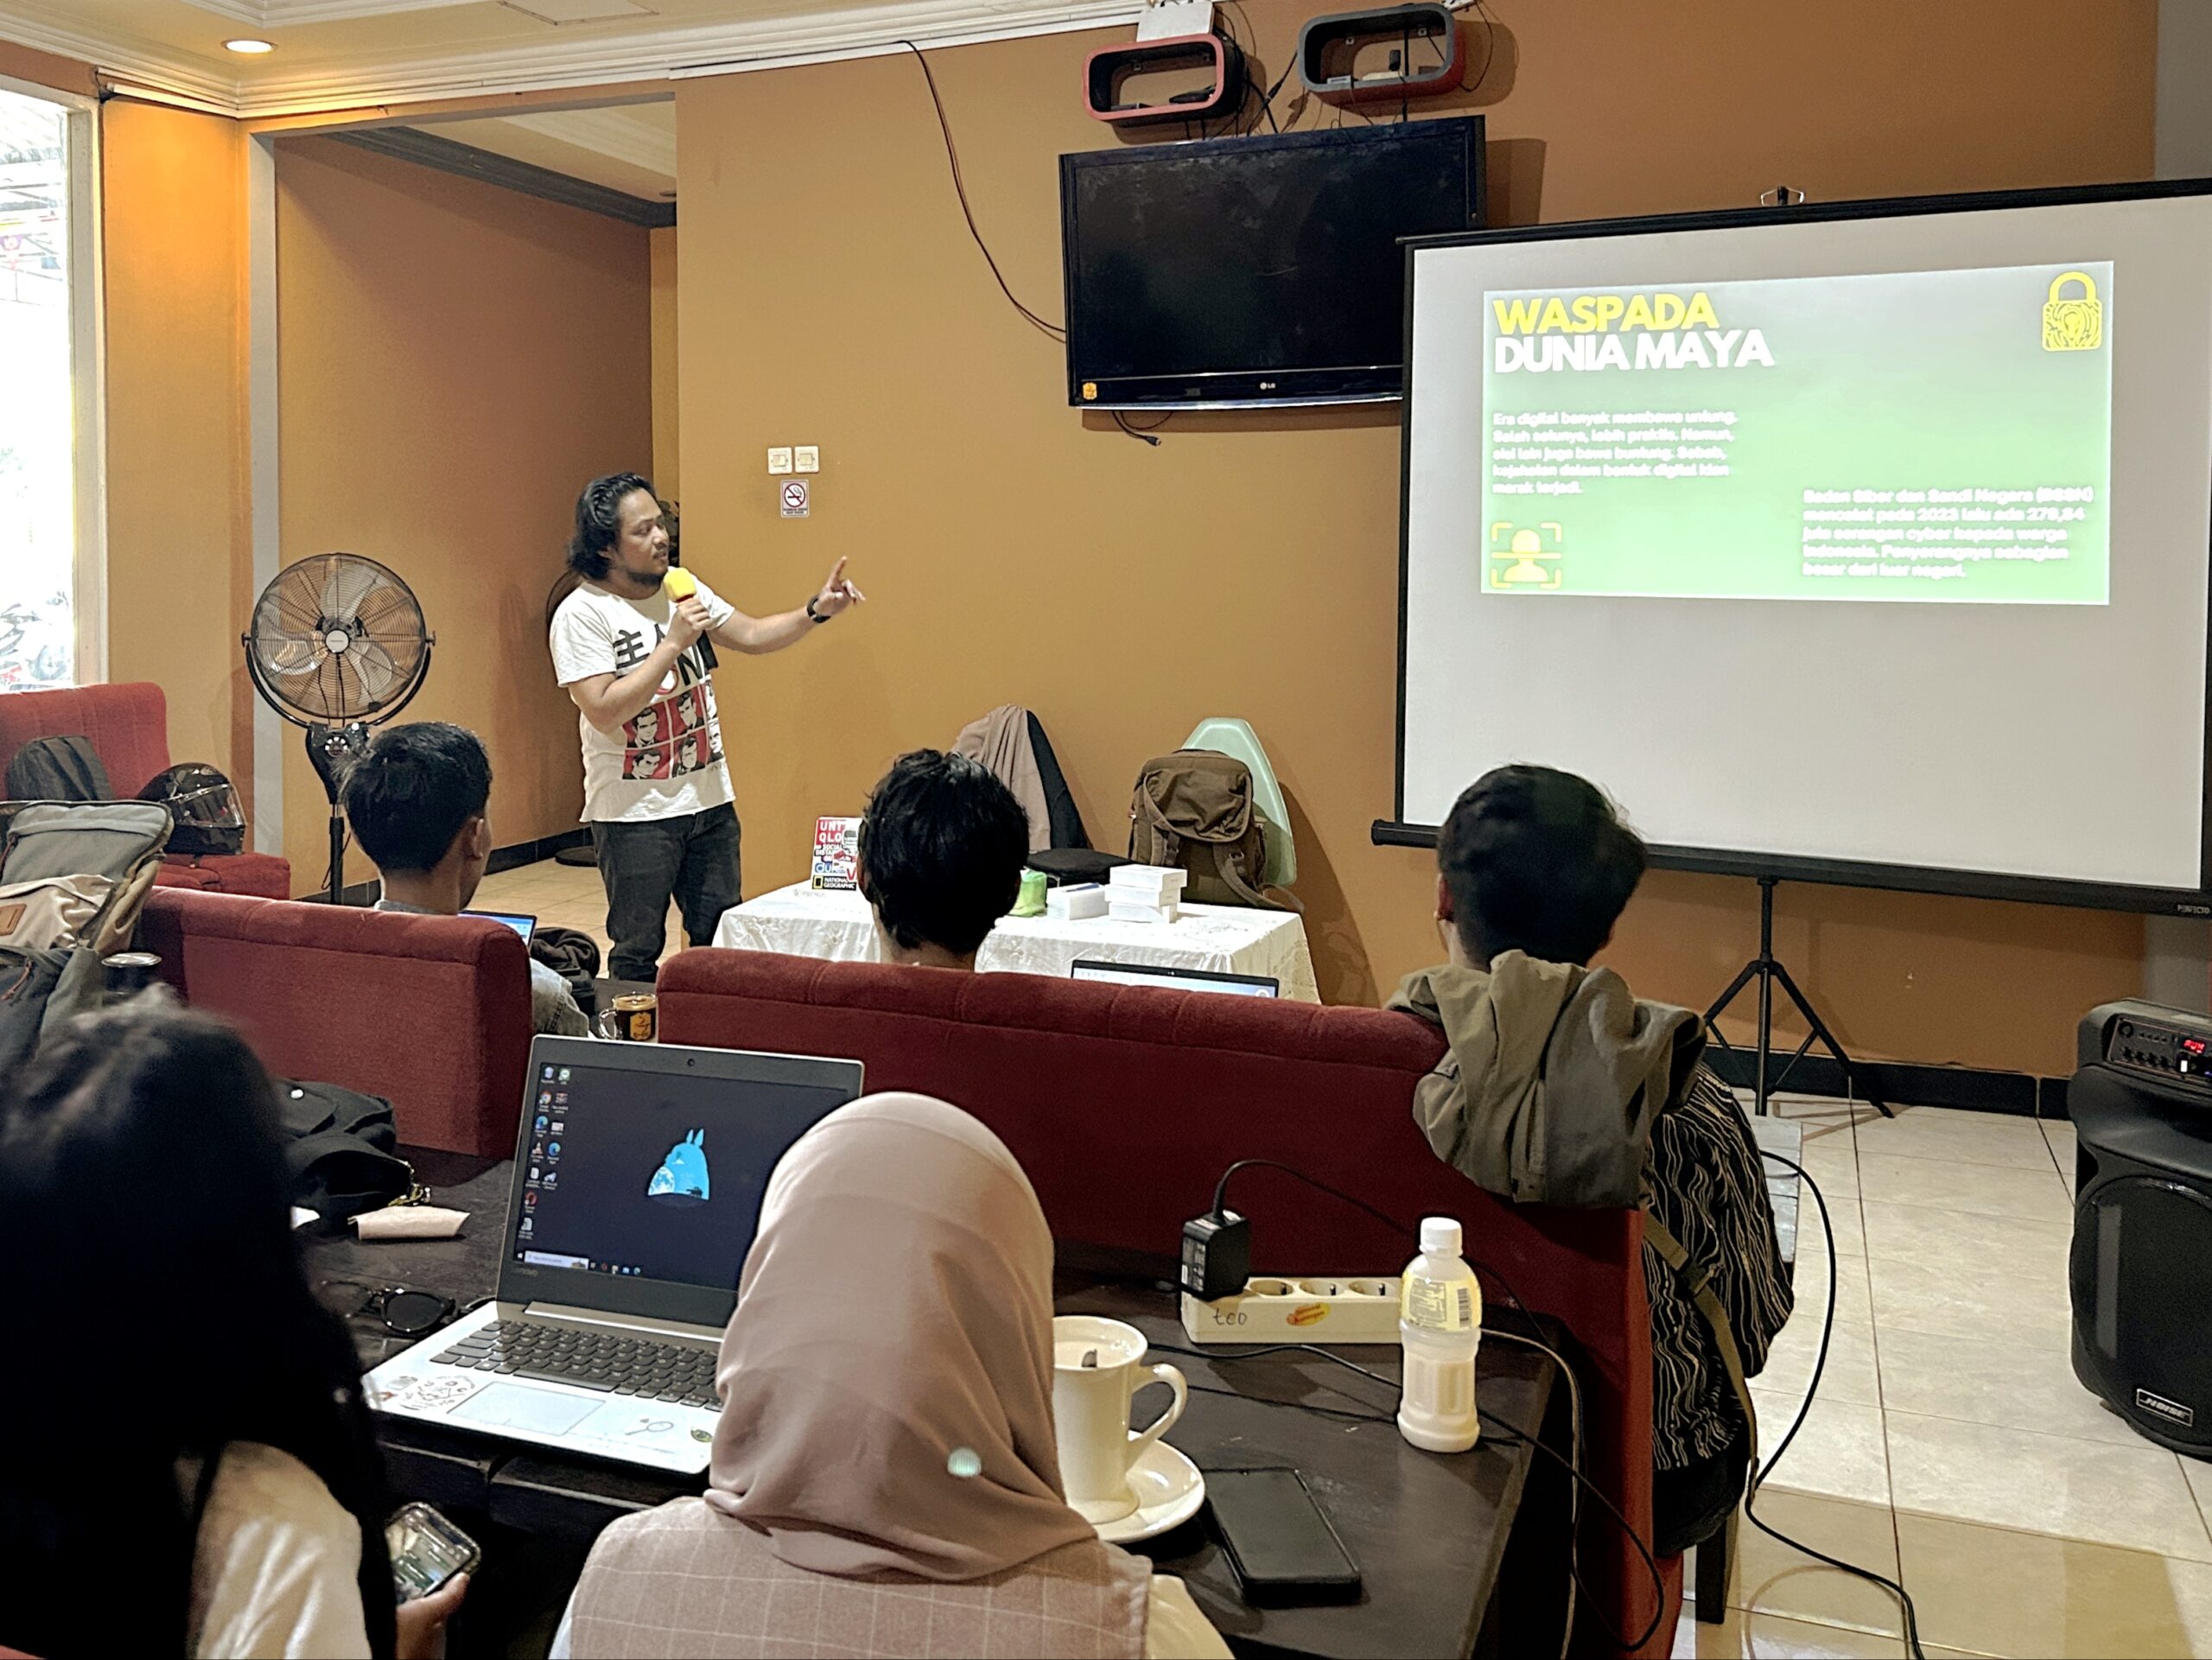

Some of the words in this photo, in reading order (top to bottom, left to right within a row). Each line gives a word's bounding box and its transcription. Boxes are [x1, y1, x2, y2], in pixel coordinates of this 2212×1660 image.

[1493, 292, 1720, 334] WASPADA
[1495, 334, 1630, 372] DUNIA
[1635, 329, 1776, 369] MAYA
[1517, 412, 1559, 427] digital
